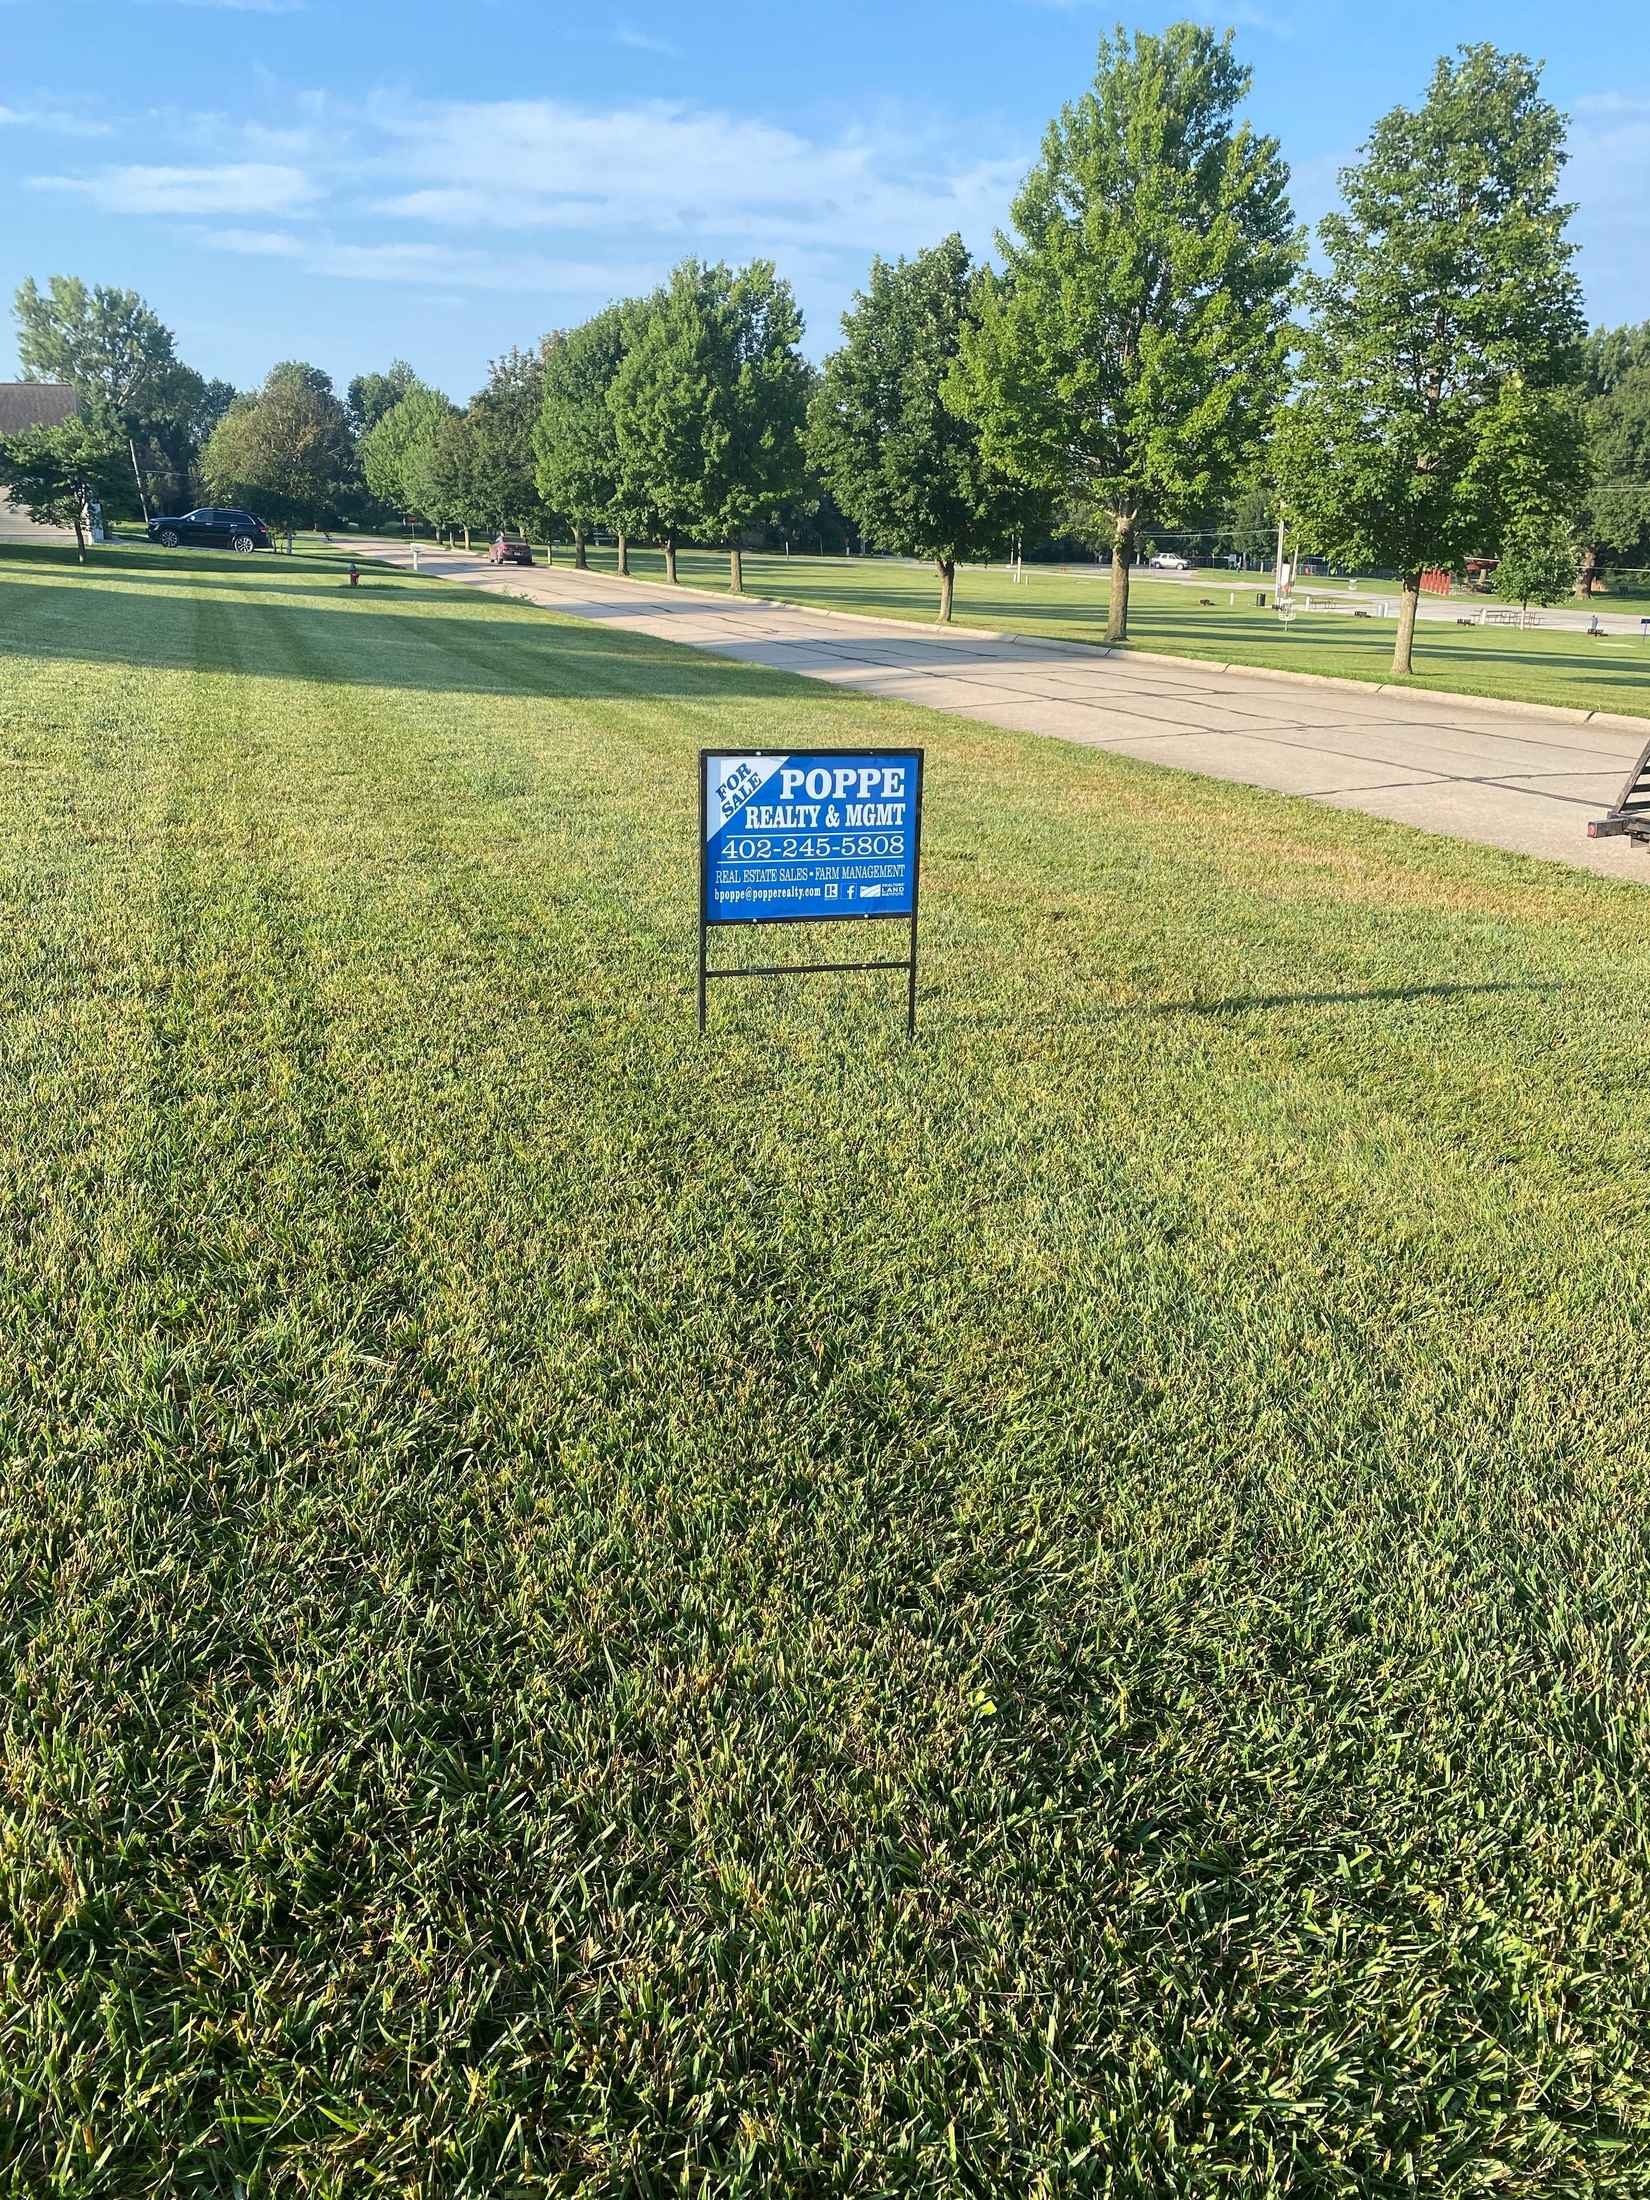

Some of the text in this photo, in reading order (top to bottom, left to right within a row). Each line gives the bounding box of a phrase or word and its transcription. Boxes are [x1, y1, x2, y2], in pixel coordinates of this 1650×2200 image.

[715, 762, 752, 802] FOR
[721, 772, 763, 818] SALE
[779, 767, 905, 800] POPPE
[745, 803, 905, 829] REALTY & MGMT
[721, 836, 904, 859] 402-245-5808
[715, 864, 905, 884] REAL ESTATE SALES FARM MANAGEMENT
[714, 885, 821, 903] bpoppe@popperealty.com
